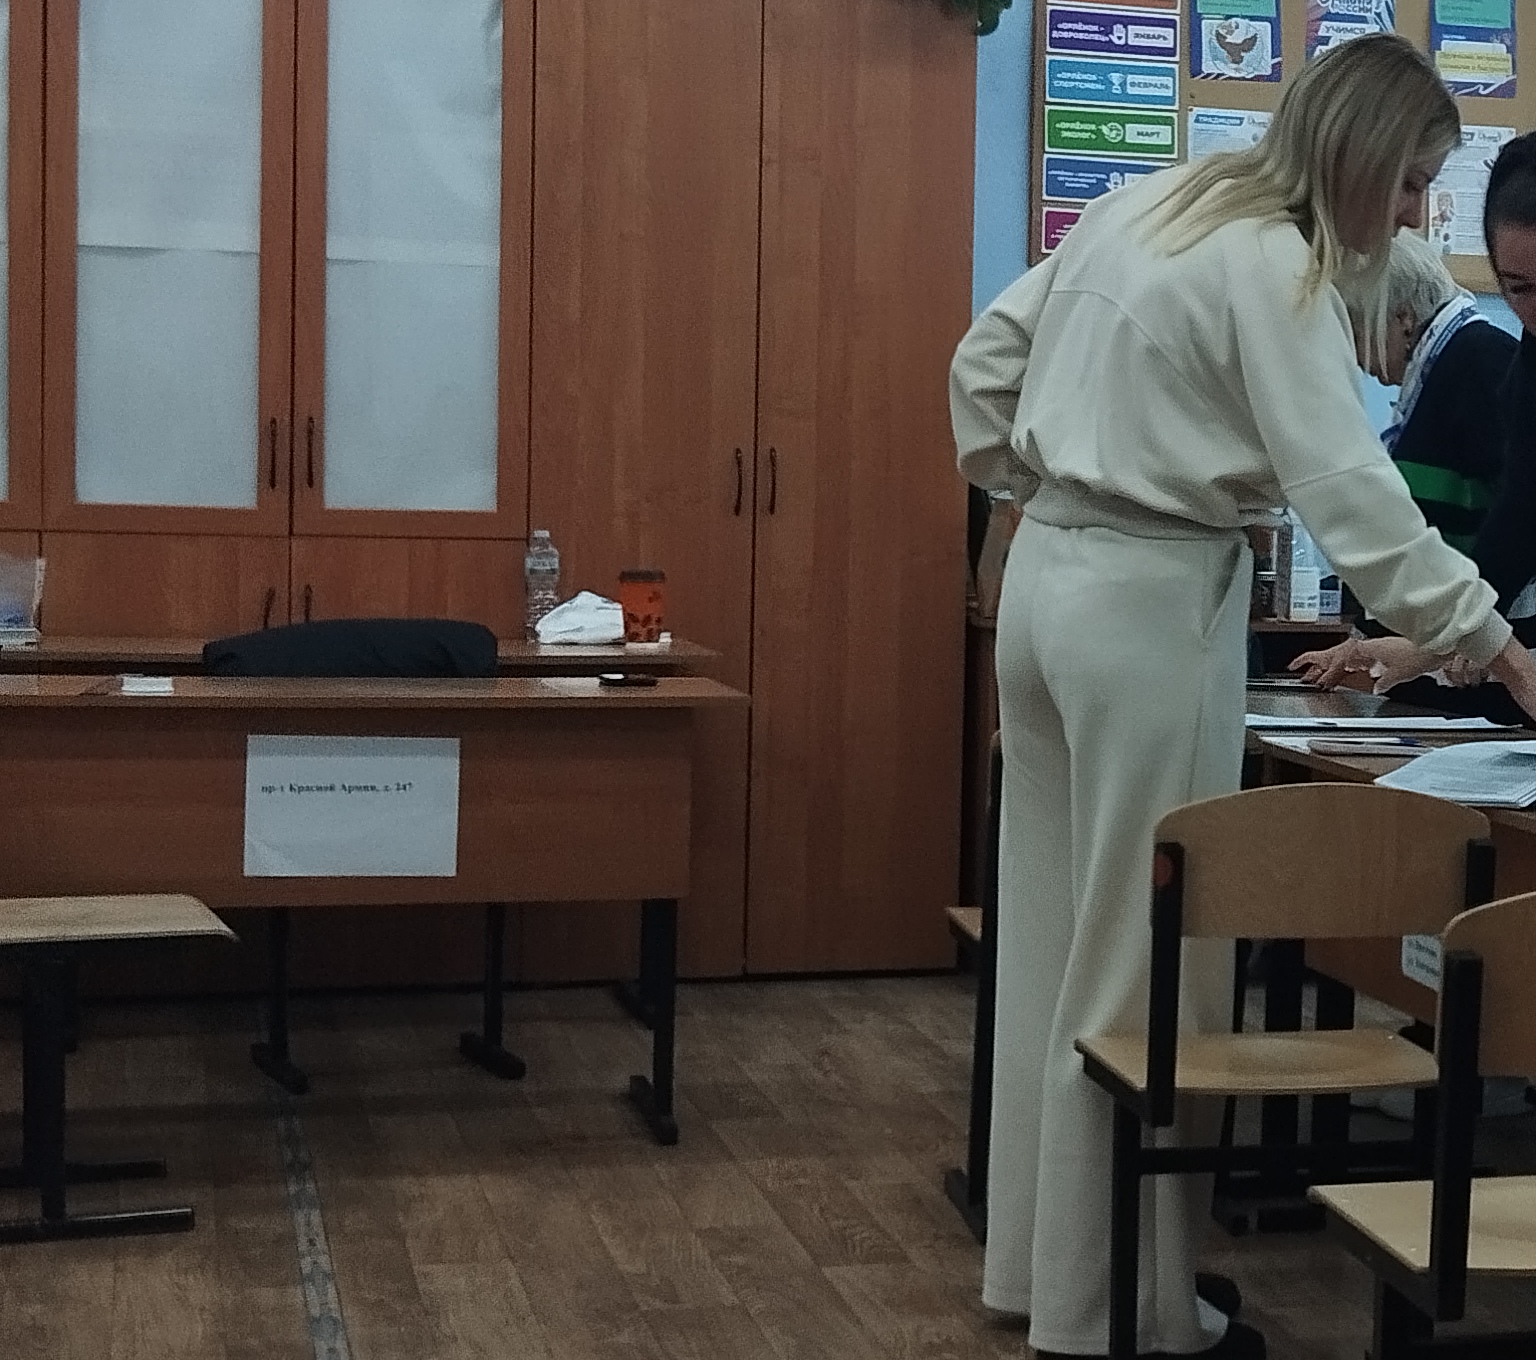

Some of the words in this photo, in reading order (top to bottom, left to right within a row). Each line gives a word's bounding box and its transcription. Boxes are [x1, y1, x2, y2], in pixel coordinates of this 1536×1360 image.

[1325, 25, 1366, 35] УЧИМСЯ
[1133, 32, 1169, 41] ЯНВАРЬ
[1129, 81, 1171, 90] ФЕВРАЛЬ
[1136, 130, 1161, 138] МАРТ
